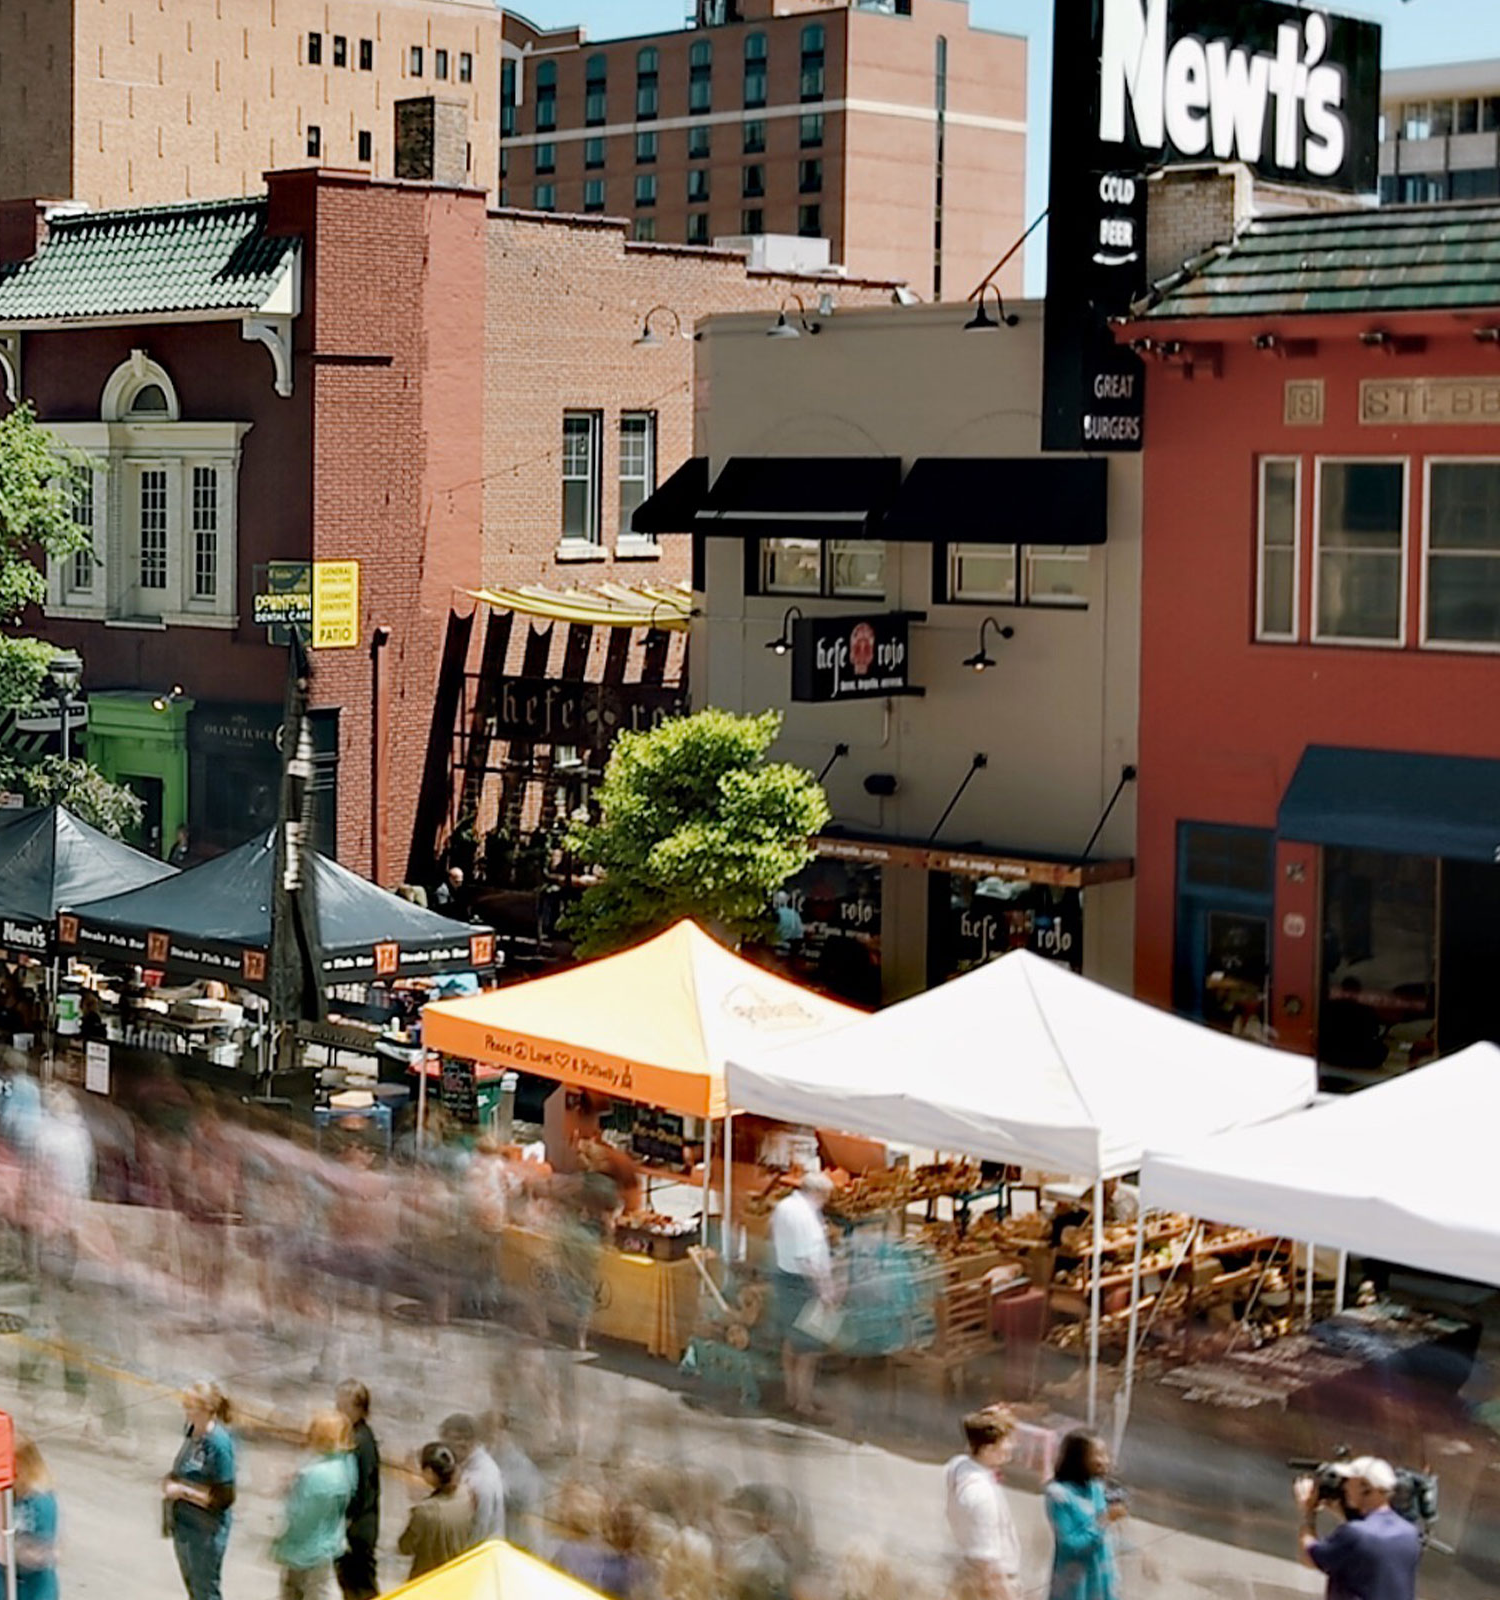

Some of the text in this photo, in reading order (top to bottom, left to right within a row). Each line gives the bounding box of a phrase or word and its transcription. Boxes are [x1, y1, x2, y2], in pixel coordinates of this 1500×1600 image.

[1100, 0, 1345, 176] Newt's
[1099, 175, 1136, 204] COLD
[1100, 218, 1134, 247] BEER
[1094, 374, 1135, 398] GREAT
[1083, 414, 1141, 440] BURGERS
[253, 594, 312, 612] DOWNTOWN
[254, 610, 312, 623] DENTAL CARE
[320, 628, 352, 641] PATIO
[816, 636, 905, 698] hefe rojo
[2, 920, 47, 948] Newt's
[961, 910, 998, 964] hefe
